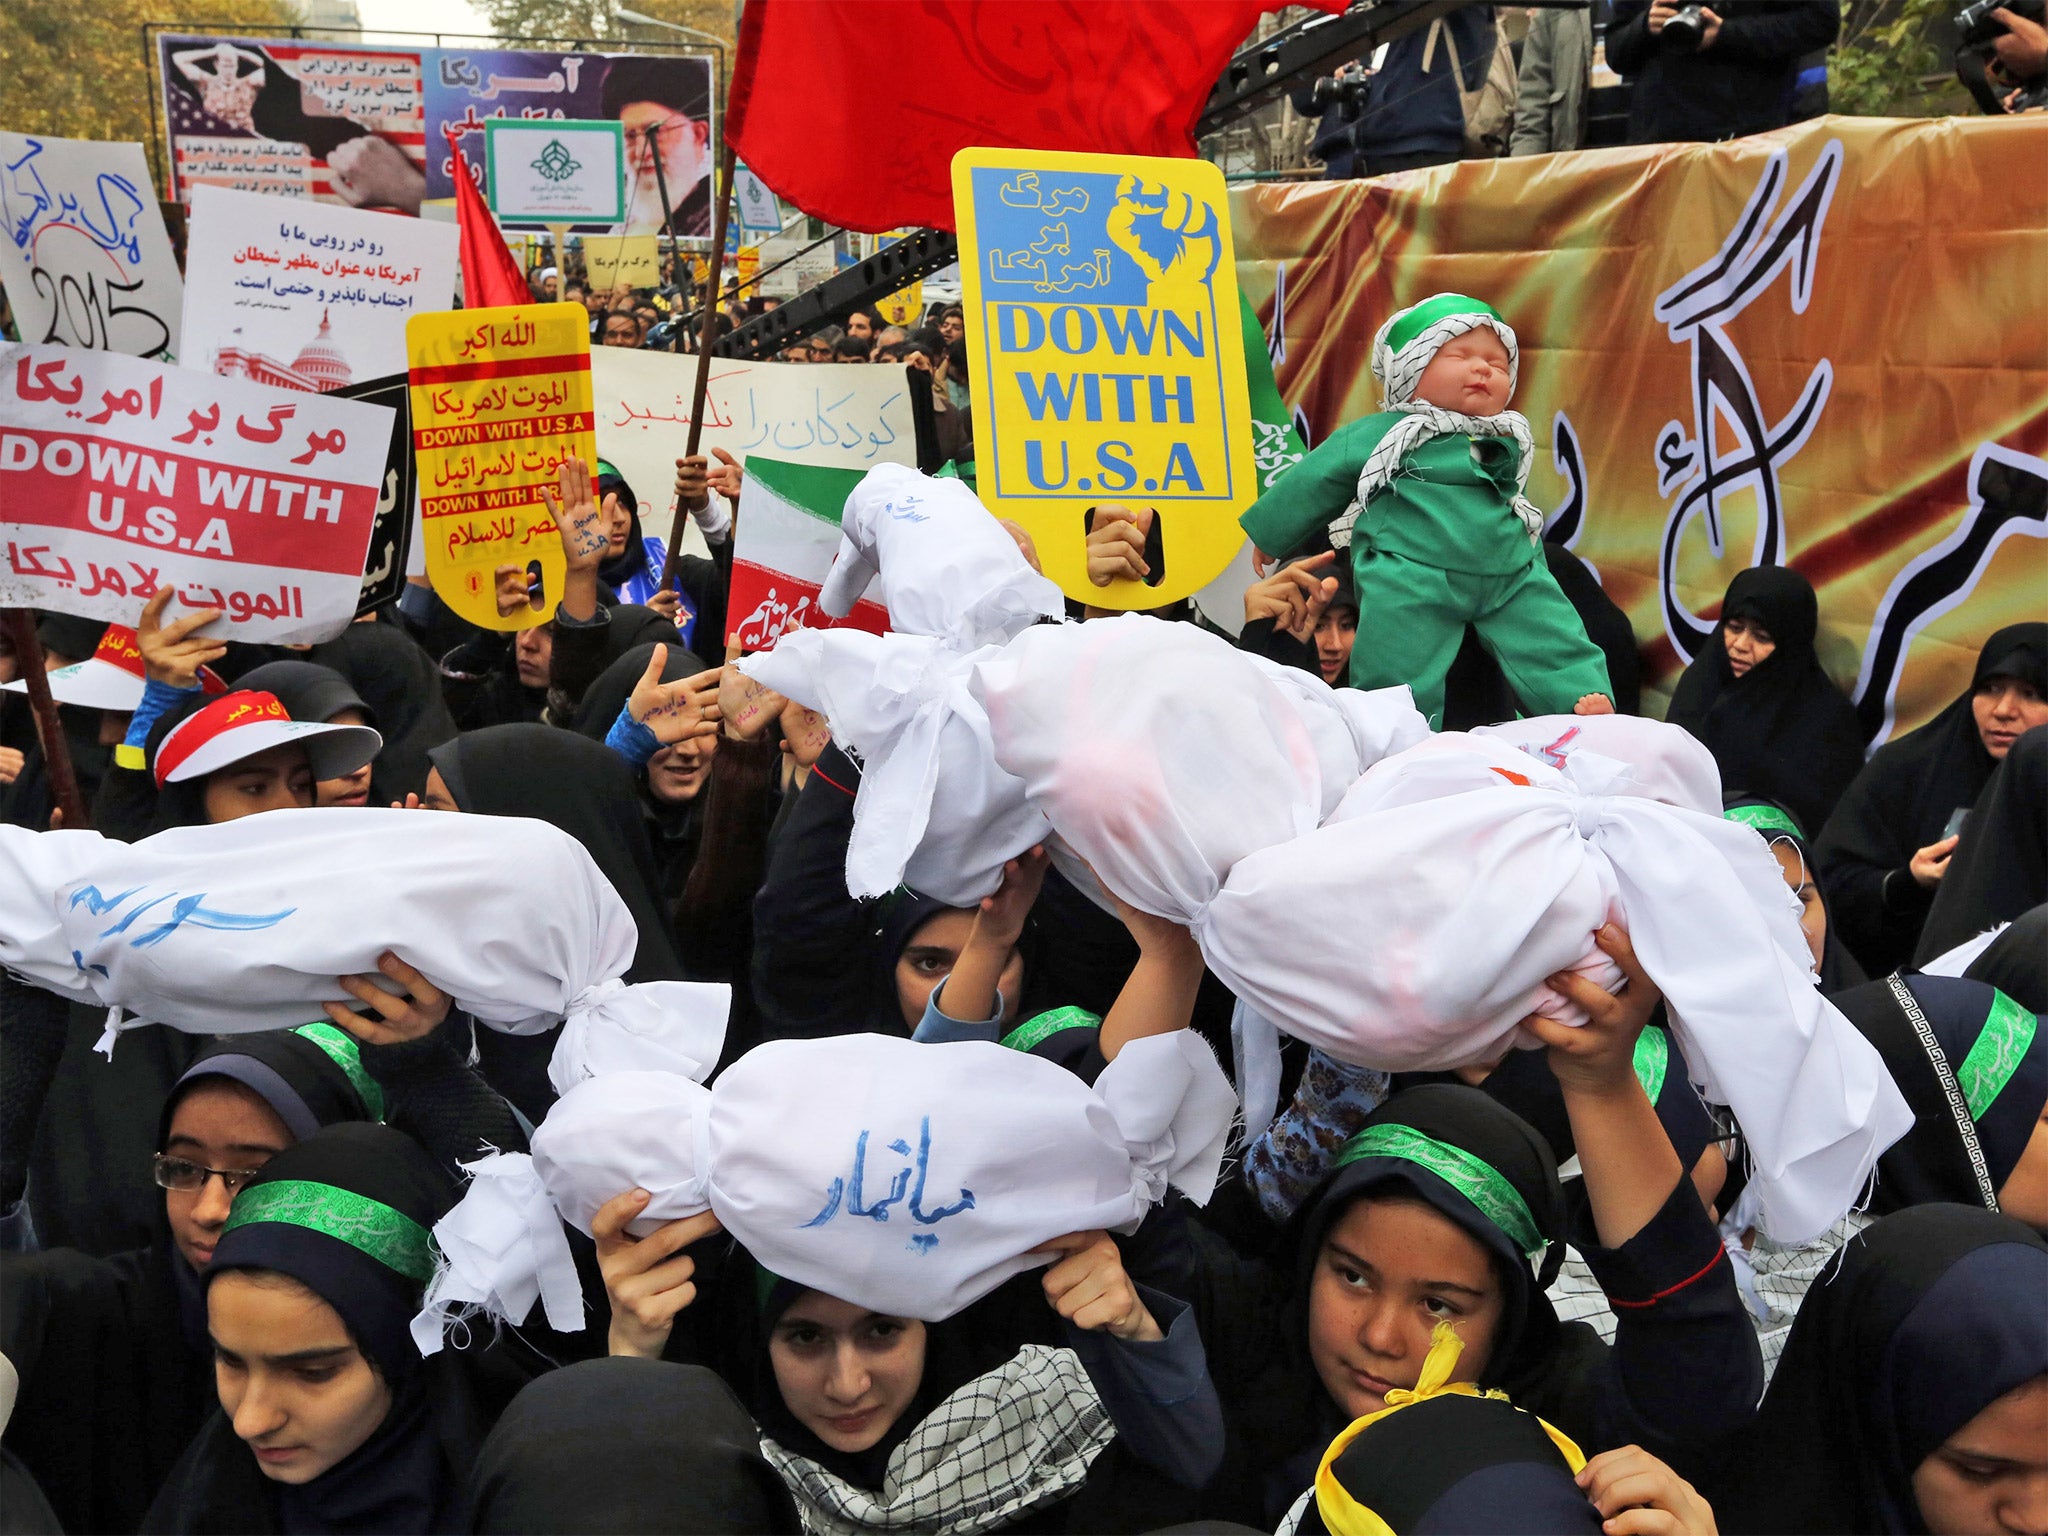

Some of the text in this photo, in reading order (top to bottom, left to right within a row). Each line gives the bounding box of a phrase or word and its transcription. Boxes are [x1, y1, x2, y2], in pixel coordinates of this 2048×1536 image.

[1000, 172, 1089, 217] مرگ
[233, 246, 280, 267] شیطان
[283, 252, 320, 270] مظهر
[1030, 221, 1070, 256] بر
[321, 258, 361, 278] عنوان
[363, 267, 376, 281] به
[31, 266, 170, 359] 2015
[997, 304, 1205, 358] DOWN
[512, 380, 568, 412] الموت
[740, 388, 768, 450] را
[1015, 371, 1195, 425] WITH
[172, 402, 220, 447] بر
[236, 403, 346, 466] مرگ
[421, 415, 585, 447] DOWN WITH U.S.A
[773, 388, 902, 459] کودکان
[0, 434, 344, 524] DOWN WITH
[1024, 440, 1205, 492] U.S.A
[88, 492, 234, 557] U.S.A
[425, 495, 479, 515] DOWN
[484, 488, 527, 507] WITH
[794, 1114, 976, 1256] میانمار
